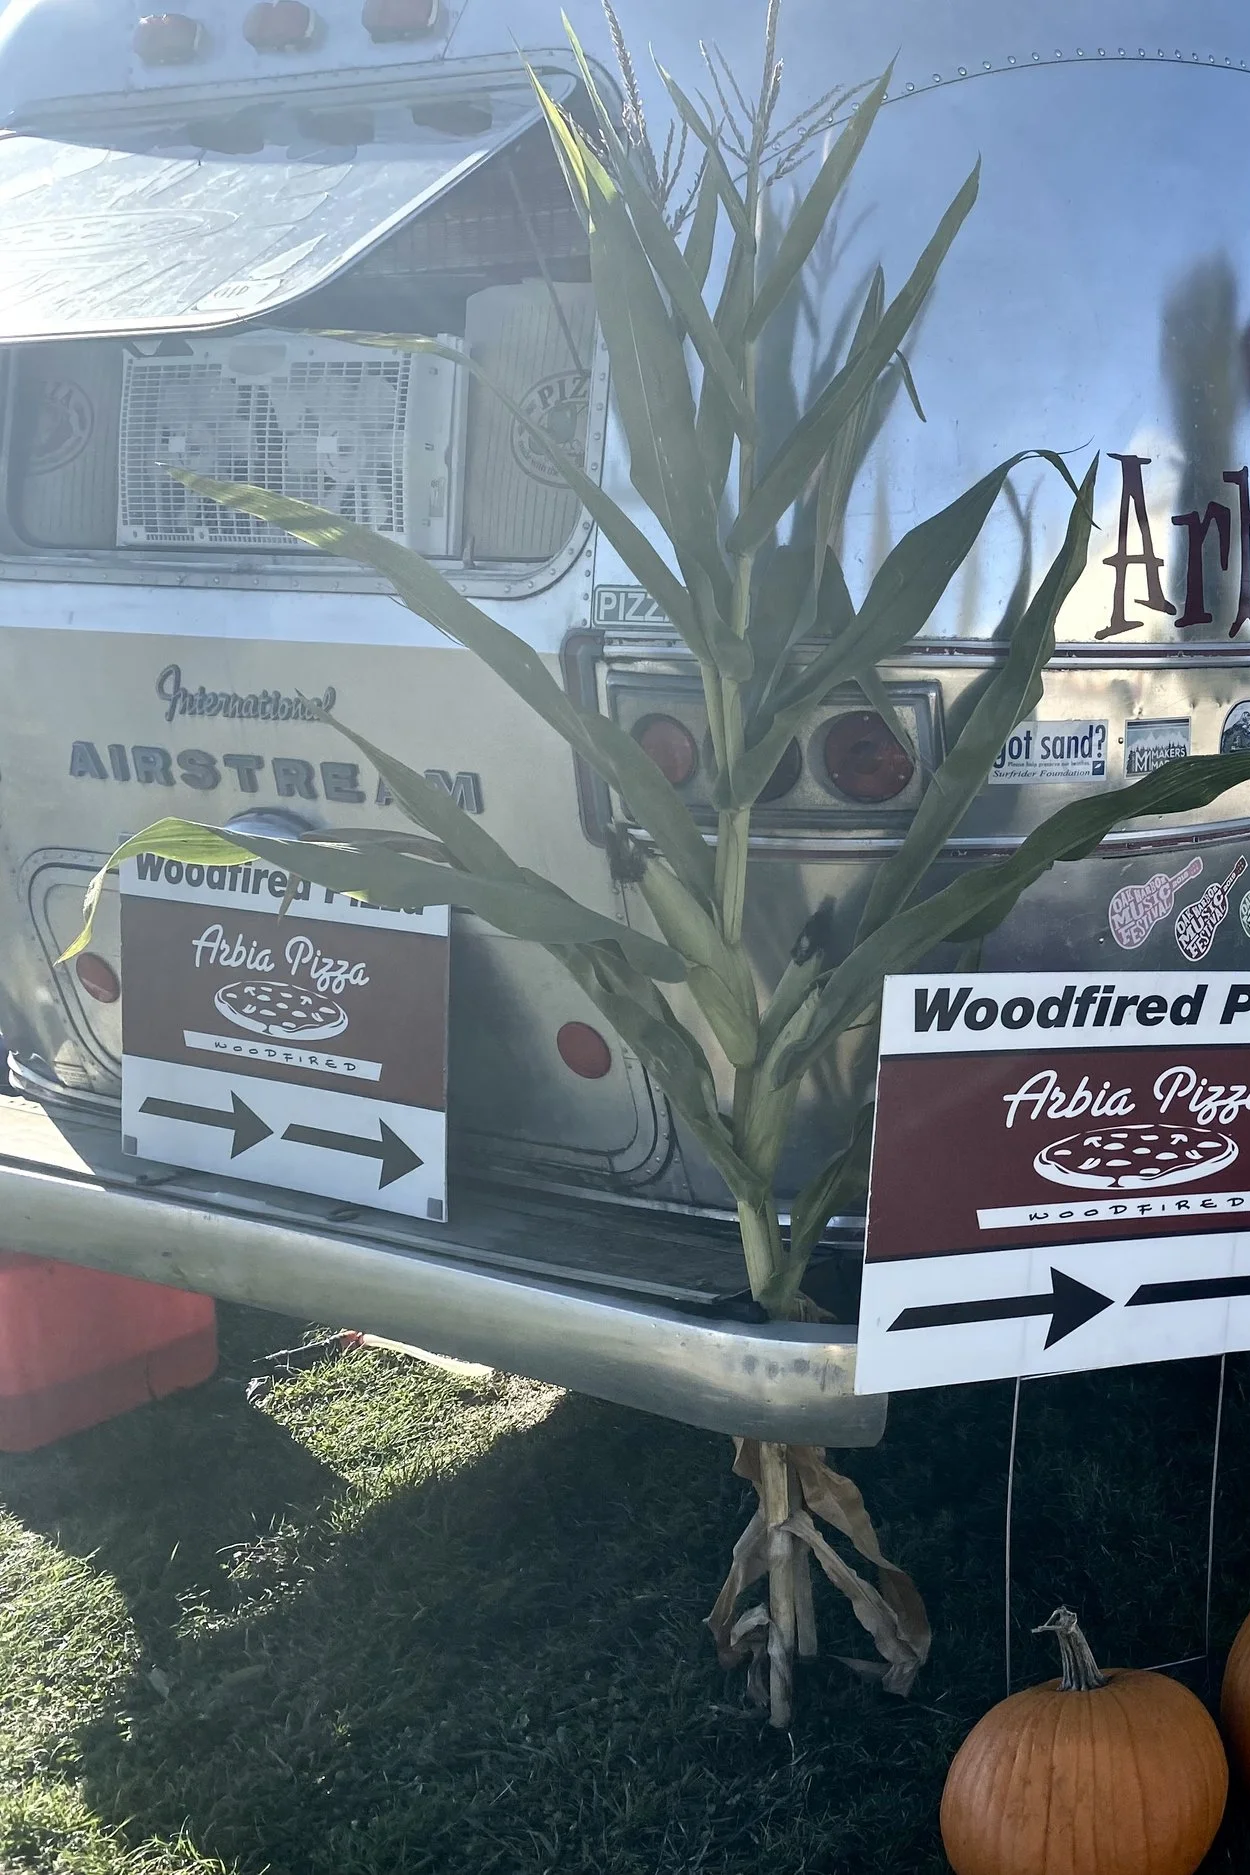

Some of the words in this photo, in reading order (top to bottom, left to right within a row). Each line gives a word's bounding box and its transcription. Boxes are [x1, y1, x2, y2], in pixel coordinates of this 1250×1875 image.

[599, 591, 671, 622] PIZZ
[155, 662, 338, 723] International
[1041, 724, 1107, 760] sand?
[1151, 747, 1186, 760] MAKERS
[69, 740, 486, 816] AIRSTREM
[992, 769, 1037, 779] Surfrider
[1039, 767, 1090, 778] Foundation
[1110, 882, 1172, 931] MUSIC
[1111, 889, 1135, 914] OAK
[1133, 876, 1167, 903] HARBOR
[1174, 906, 1195, 935] OAK
[1192, 885, 1218, 918] HARBOR
[1178, 889, 1224, 950] MUSIC
[1117, 899, 1172, 946] FESTIVAL
[1185, 903, 1227, 959] FESTIVAL
[192, 923, 276, 973] Arbia
[284, 935, 370, 995] Pizza
[912, 984, 1208, 1034] Woodfired
[214, 1040, 358, 1073] WOODFIRED
[1002, 1069, 1136, 1129] Arbia
[1028, 1195, 1246, 1223] WOODFIRED
